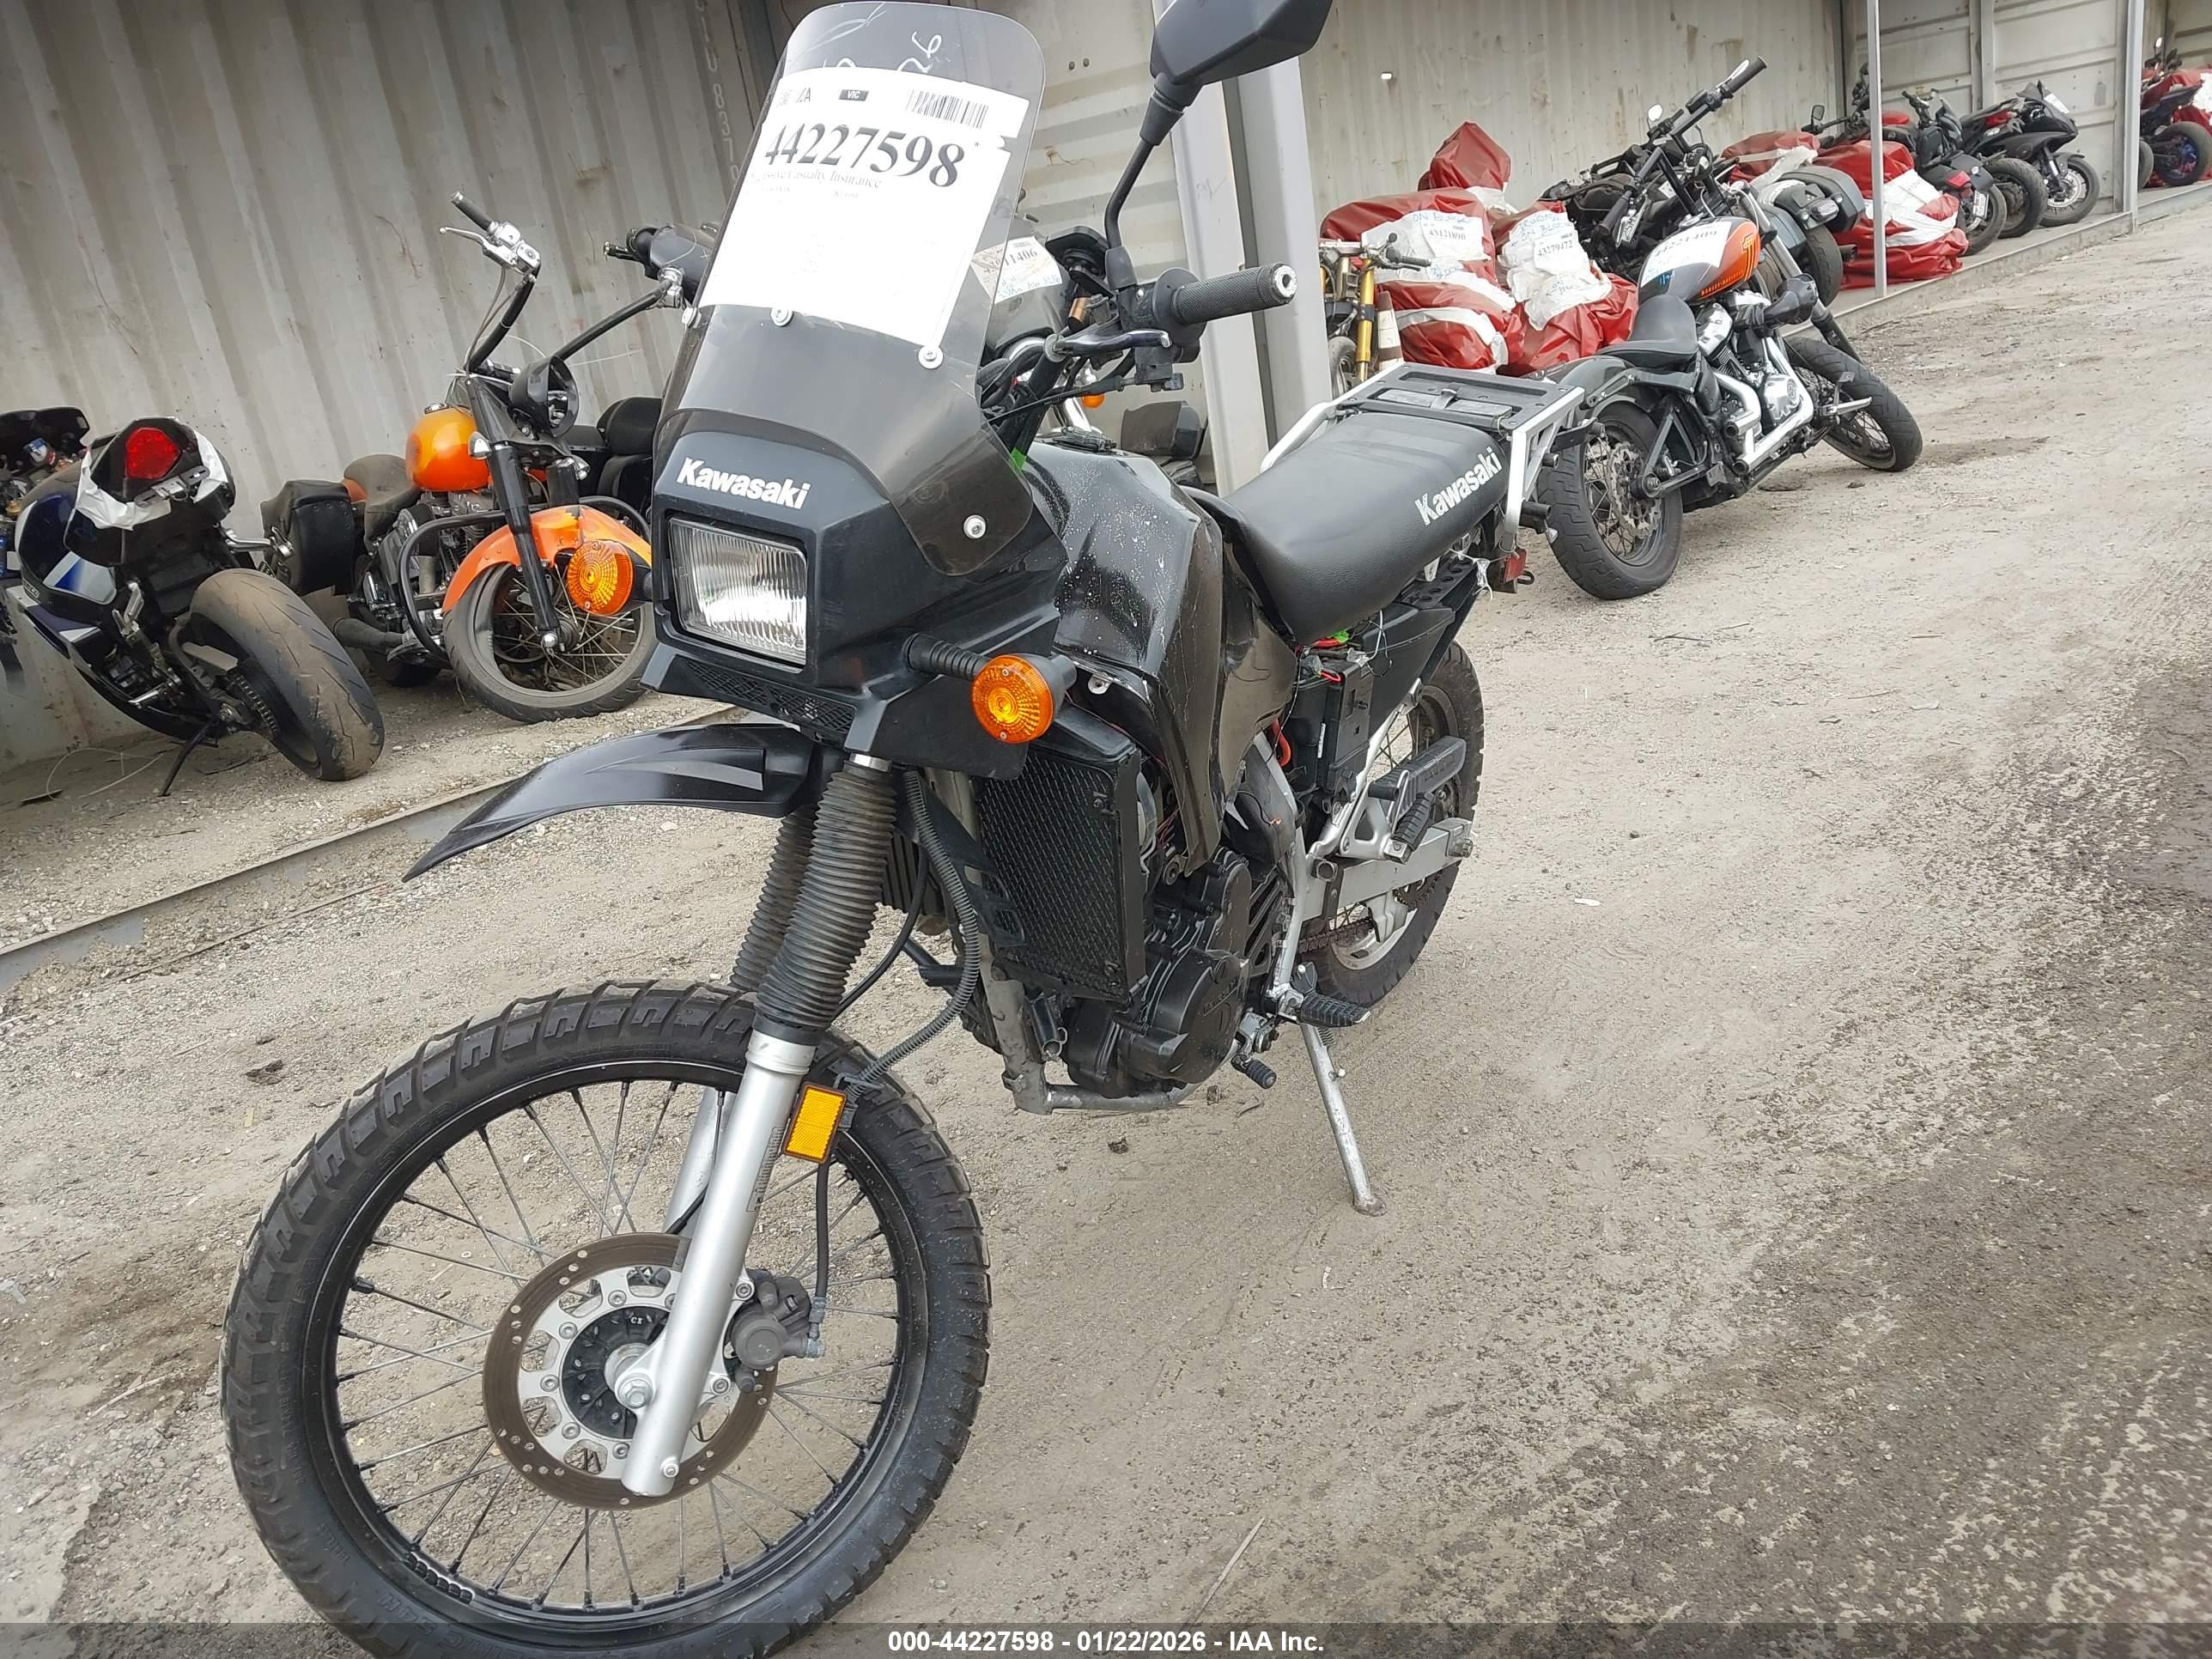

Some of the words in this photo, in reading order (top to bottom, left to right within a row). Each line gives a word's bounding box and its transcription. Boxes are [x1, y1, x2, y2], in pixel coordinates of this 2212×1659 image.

[847, 90, 861, 100] VIC
[765, 123, 965, 188] 44227598
[677, 457, 811, 509] Kawasaki
[1414, 447, 1503, 526] Kawasaki
